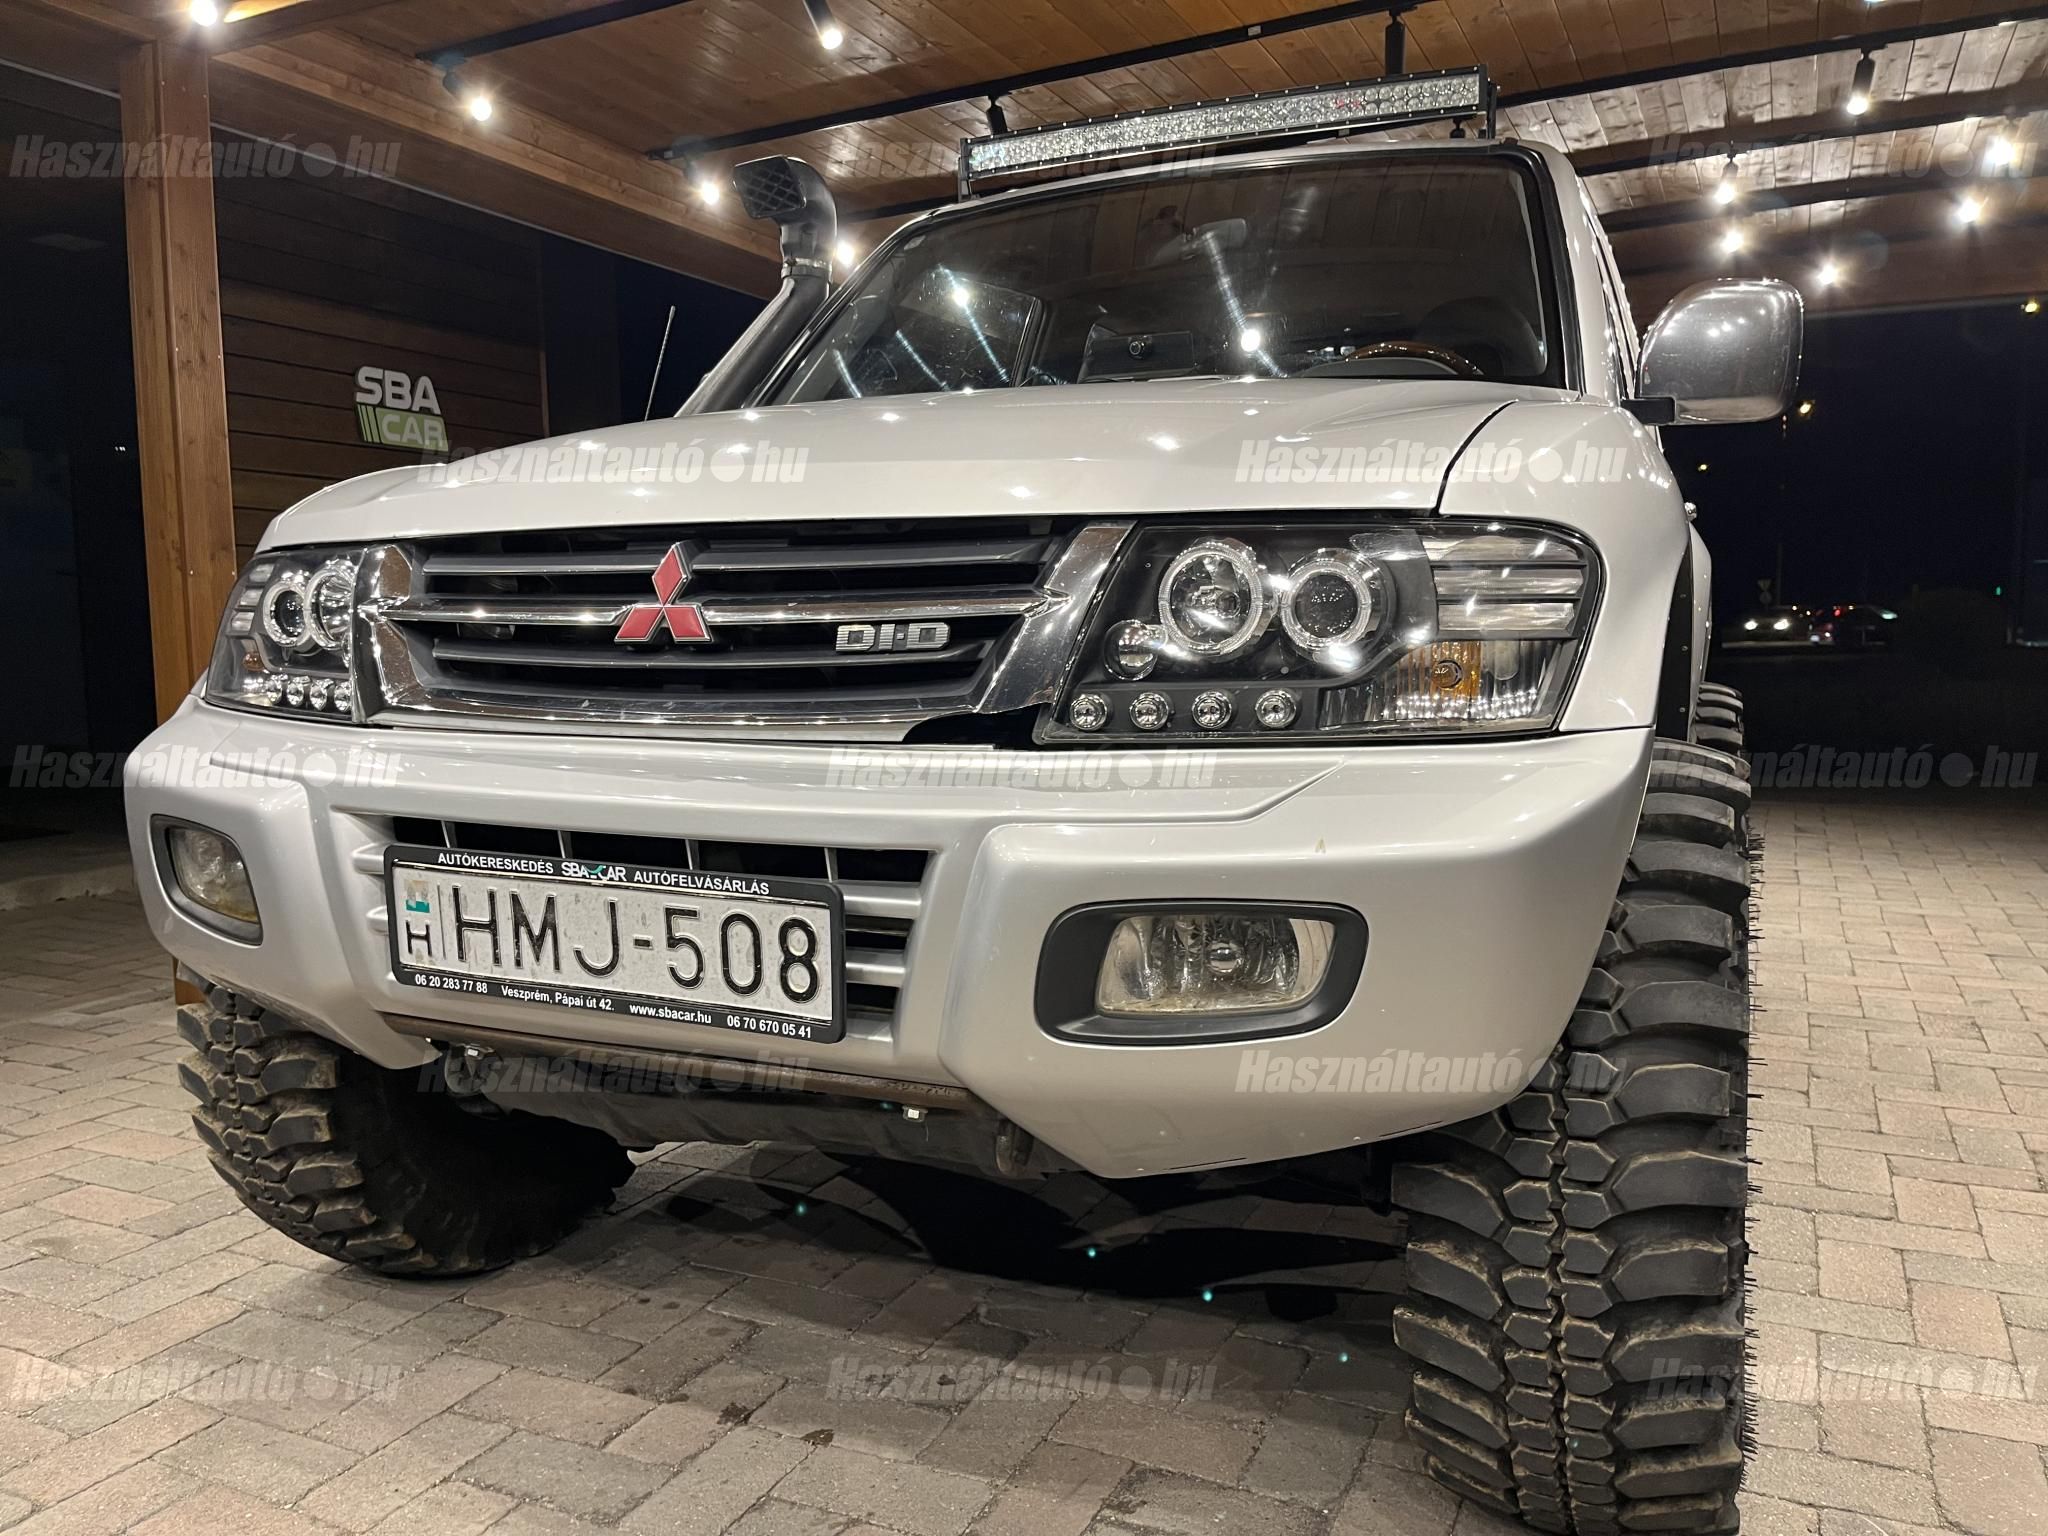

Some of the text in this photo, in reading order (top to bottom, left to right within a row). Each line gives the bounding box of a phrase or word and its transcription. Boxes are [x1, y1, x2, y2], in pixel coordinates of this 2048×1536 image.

[356, 366, 442, 415] SBA
[381, 413, 443, 448] CAR
[438, 853, 554, 874] AUTÓKERESKEDÉS
[634, 871, 770, 896] AUTÓFELVÁSÁRLÁS
[405, 920, 432, 957] H
[452, 884, 819, 1003] HMJ-508
[415, 974, 811, 1039] 06 20 283 77 88 Veszprém, Pápai út 42. www.sbacar.hu 06 70 670 05 41
